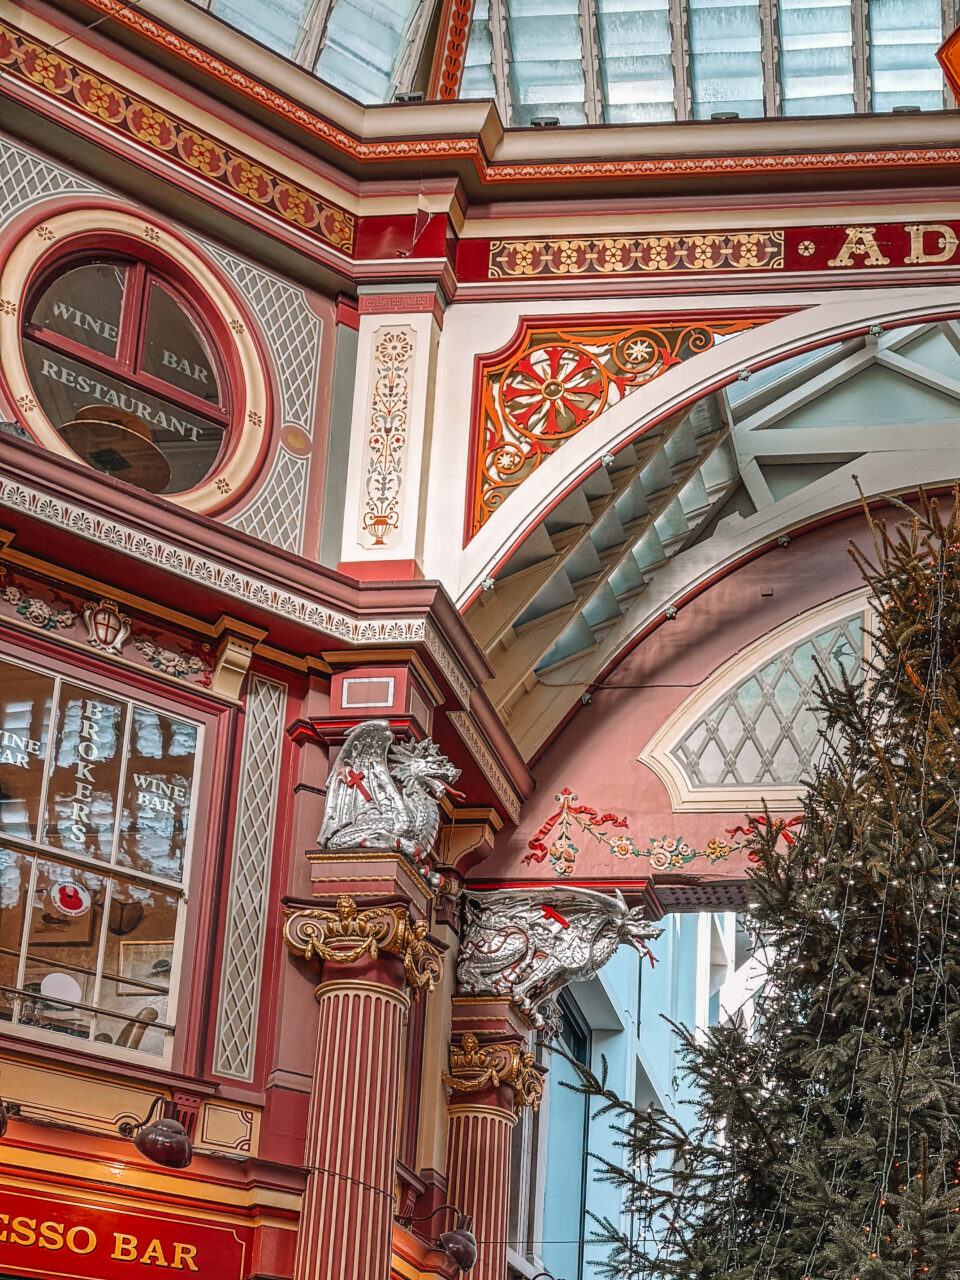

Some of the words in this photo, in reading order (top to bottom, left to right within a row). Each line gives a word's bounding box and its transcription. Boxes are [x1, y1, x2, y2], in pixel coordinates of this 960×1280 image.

[828, 224, 959, 267] AD
[52, 302, 118, 342] WINE
[162, 349, 209, 385] BAR
[40, 359, 203, 442] RESTAURANT
[0, 730, 41, 755] INE
[0, 748, 30, 770] AR
[70, 699, 103, 843] BROKERS
[133, 773, 186, 801] WINE
[137, 791, 176, 815] BAR
[111, 1232, 199, 1273] BAR
